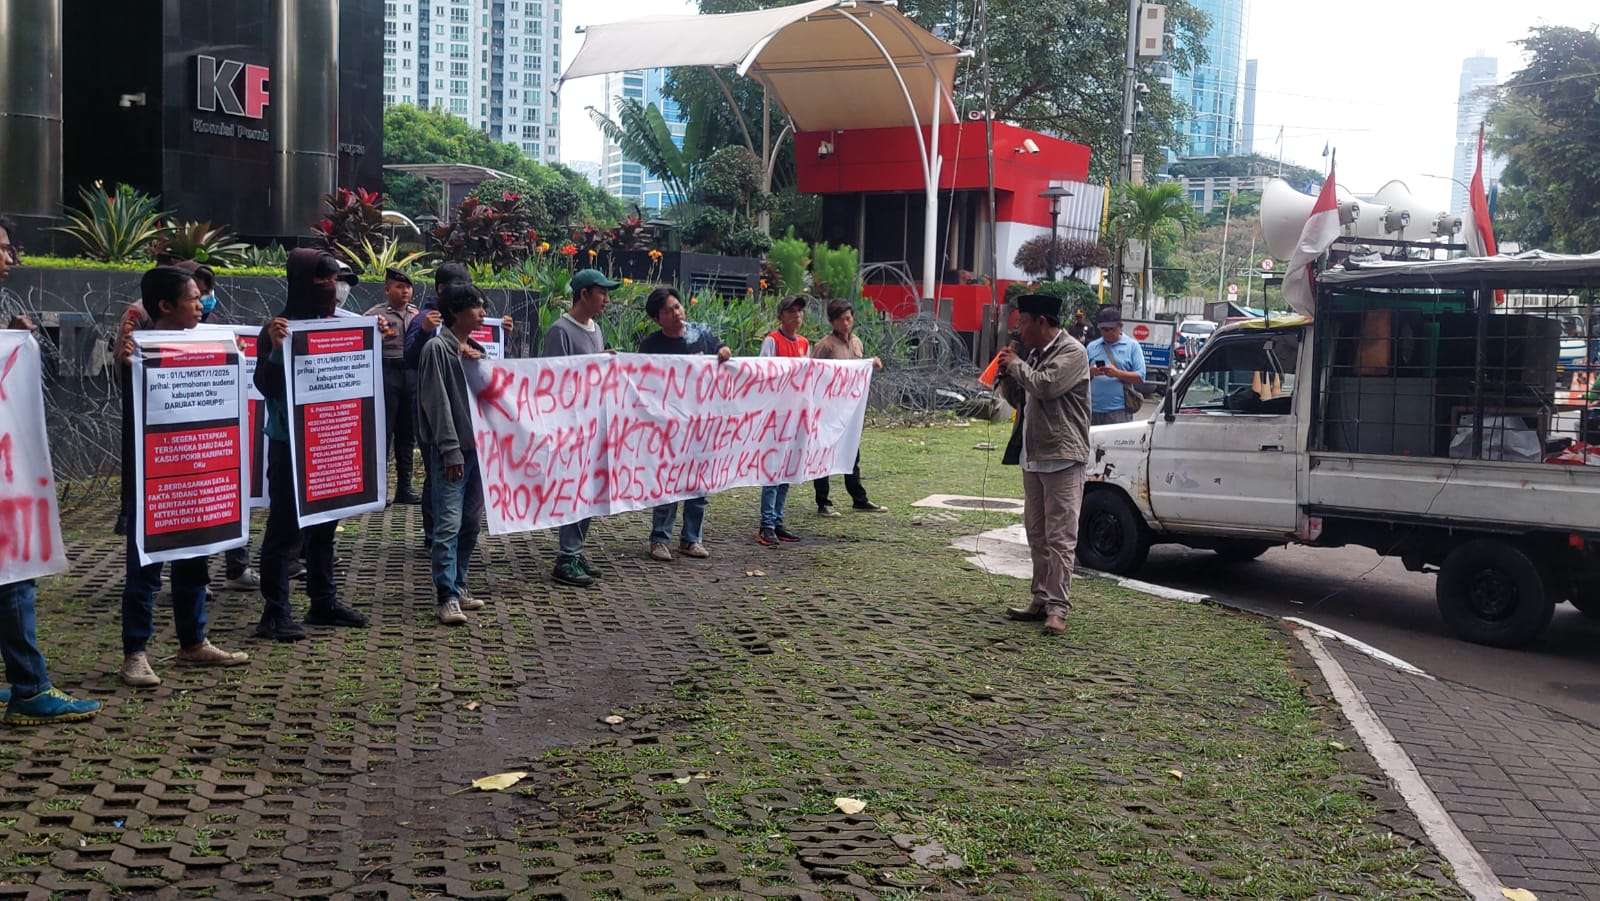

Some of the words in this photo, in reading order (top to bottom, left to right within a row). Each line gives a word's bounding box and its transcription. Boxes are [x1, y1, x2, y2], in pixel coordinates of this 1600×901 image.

[165, 401, 195, 409] DARURAT
[172, 435, 197, 443] SEGERA
[155, 444, 197, 454] TERSANGKA
[155, 455, 179, 463] KASUS
[172, 490, 198, 499] SIDANG
[155, 520, 180, 528] BUPATI
